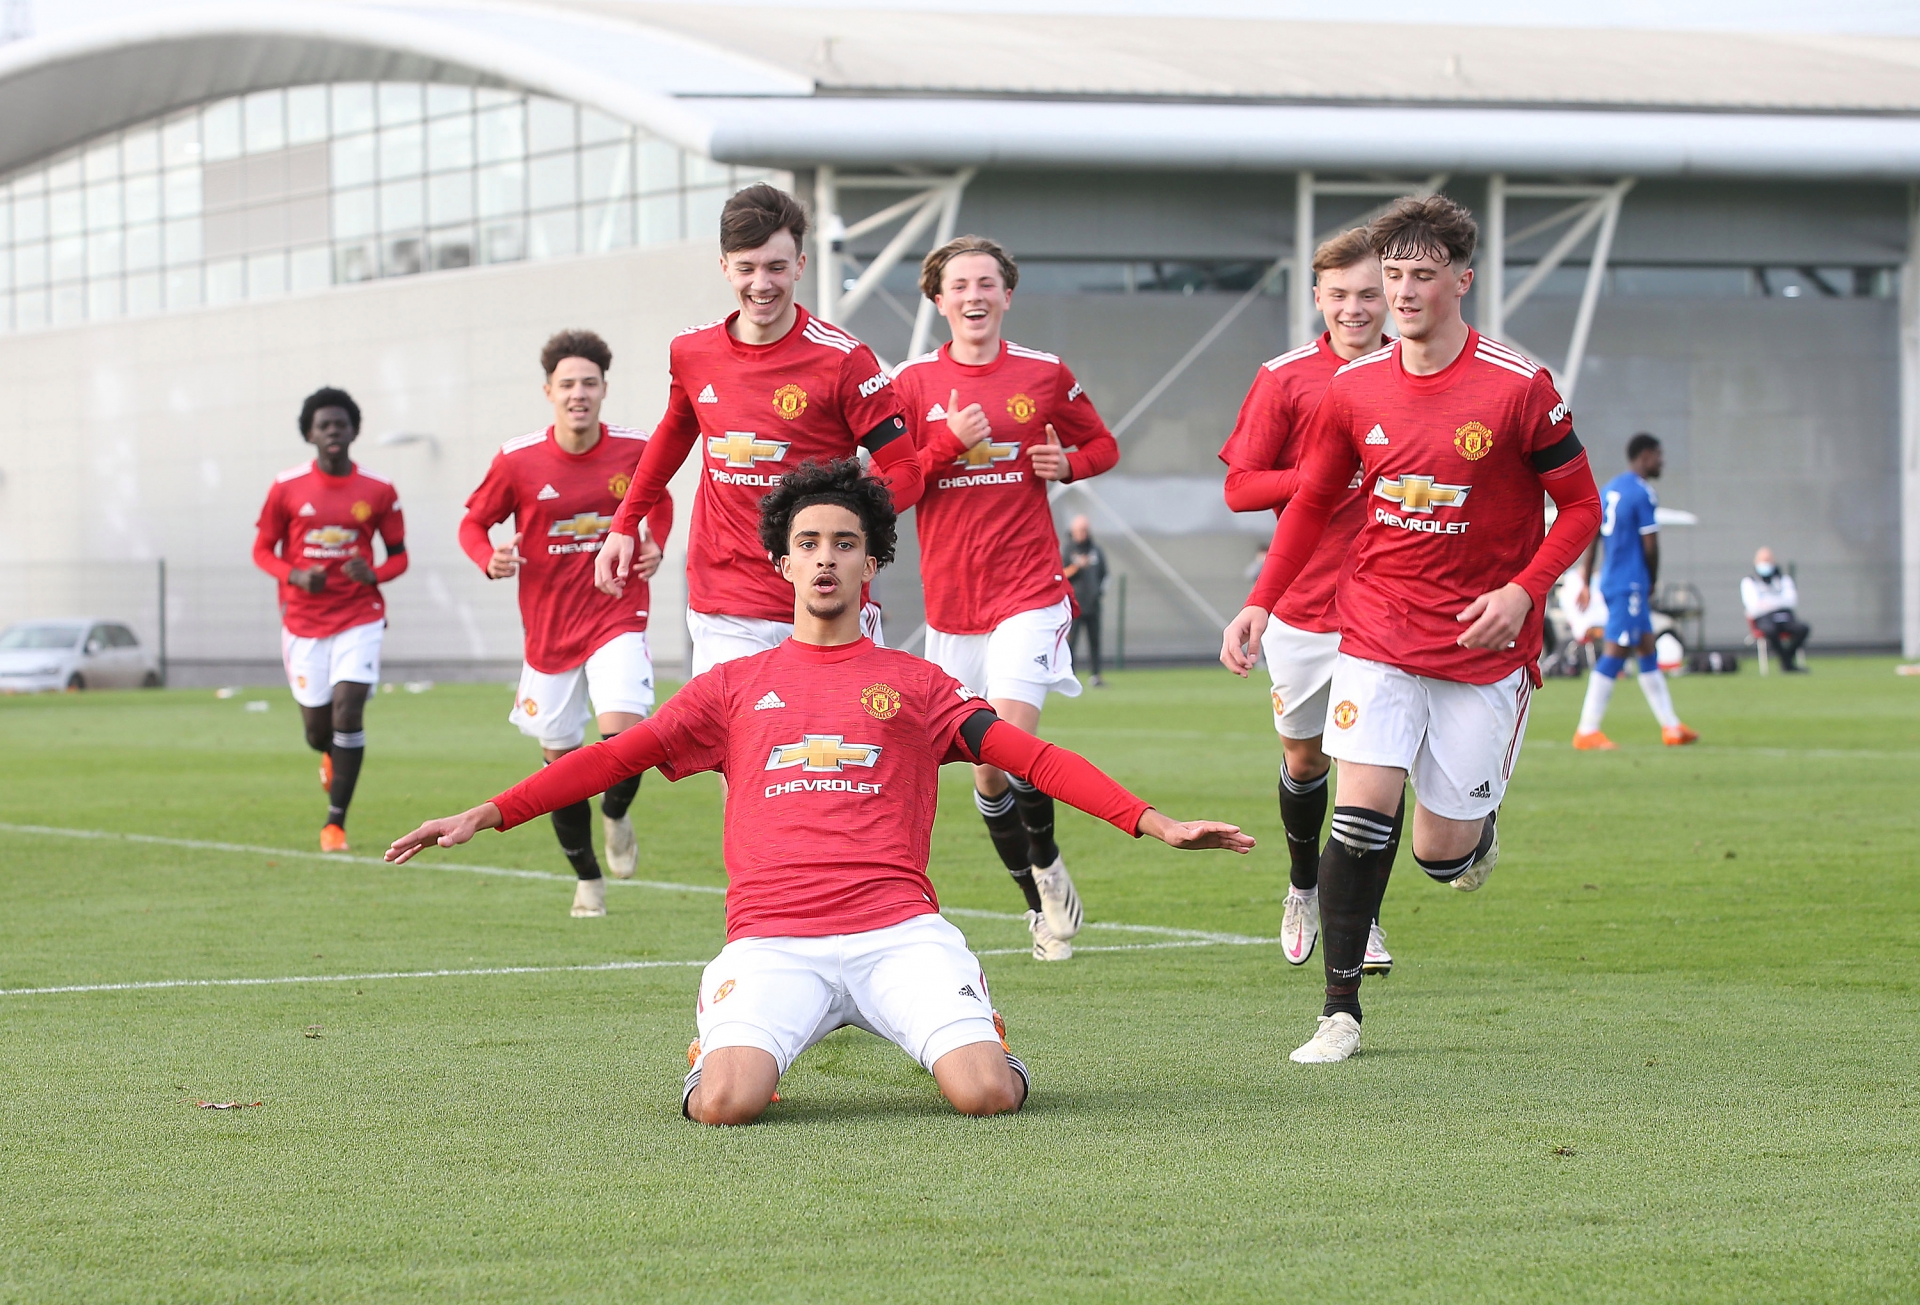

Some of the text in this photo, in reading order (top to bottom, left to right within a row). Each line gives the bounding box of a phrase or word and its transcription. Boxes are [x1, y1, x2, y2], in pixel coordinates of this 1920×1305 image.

[1364, 436, 1390, 446] adidas
[938, 471, 1024, 489] CHEVROLET
[1375, 507, 1470, 534] CHEVROLET
[863, 684, 900, 701] MANCHESTER
[753, 701, 787, 711] adidas
[868, 708, 893, 719] UNITED
[764, 779, 883, 799] CHEVROLET
